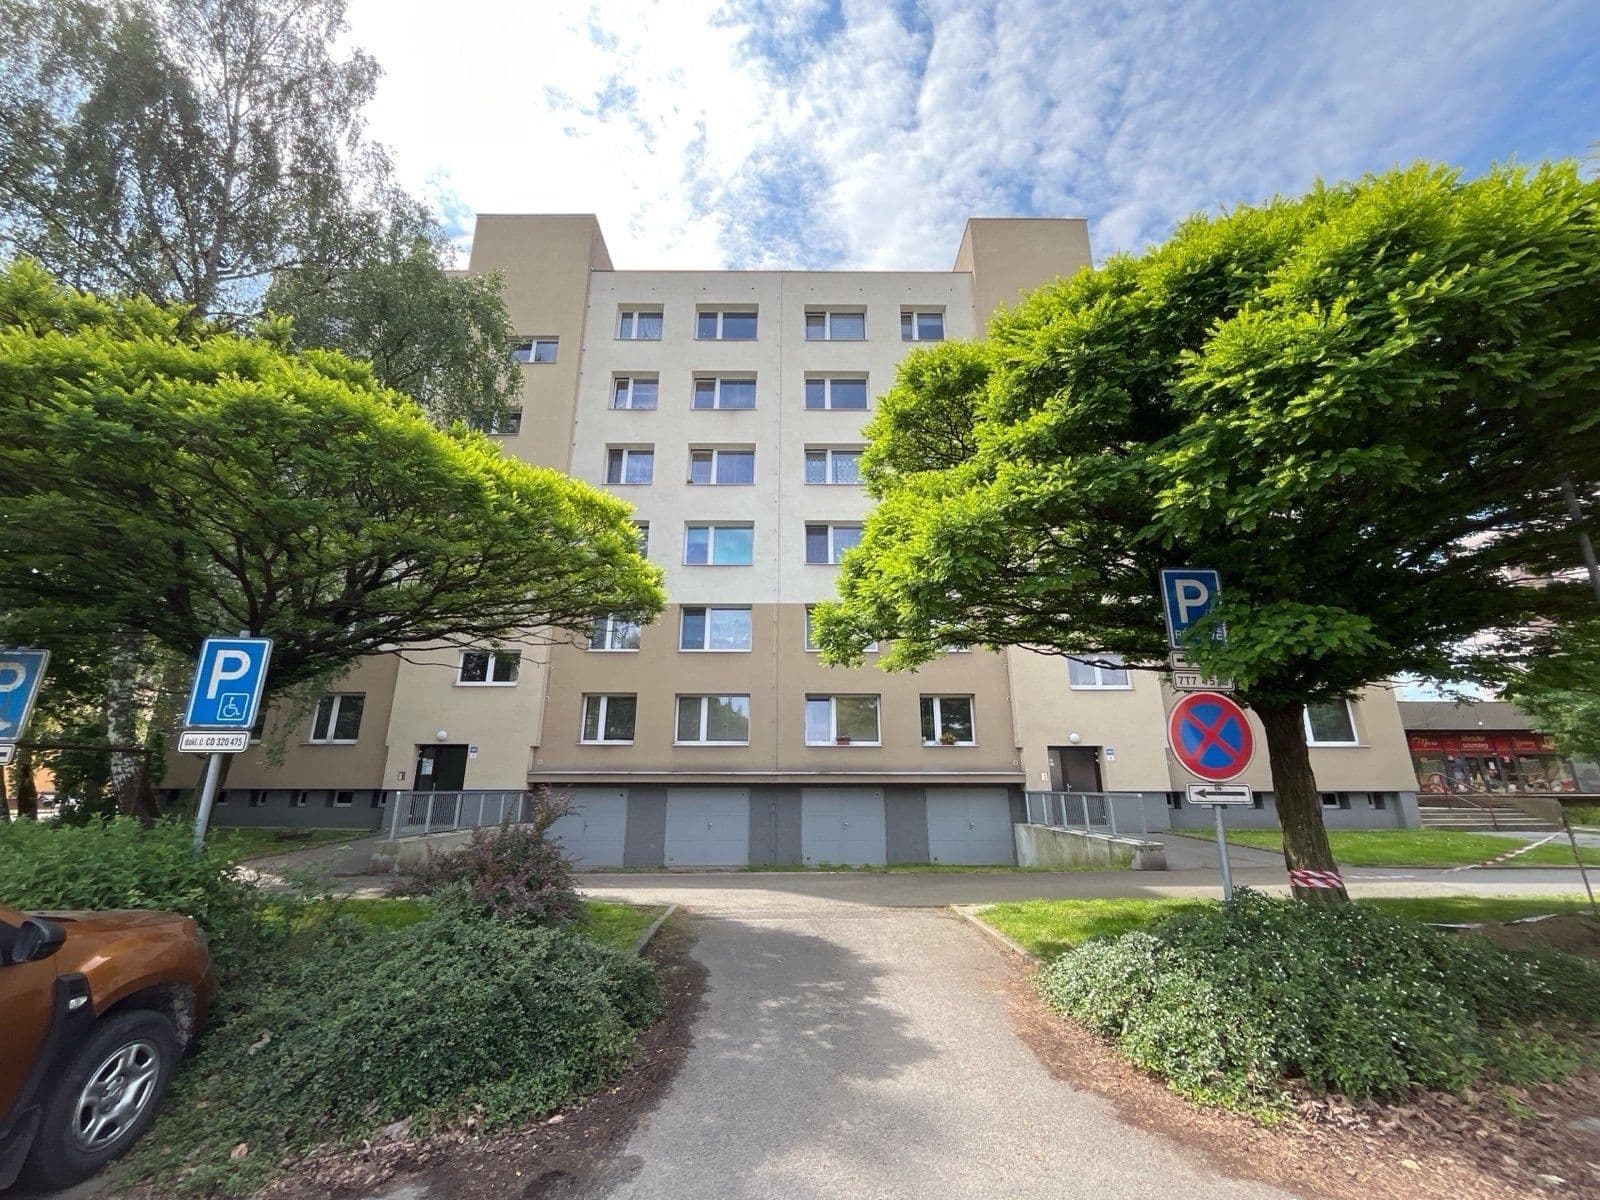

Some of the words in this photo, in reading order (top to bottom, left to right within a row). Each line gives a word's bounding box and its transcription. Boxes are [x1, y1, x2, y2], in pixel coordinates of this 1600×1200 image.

[1174, 579, 1209, 624] P
[206, 650, 250, 699] P
[1178, 676, 1197, 686] 7T7
[216, 737, 229, 746] 320
[230, 737, 243, 747] 475
